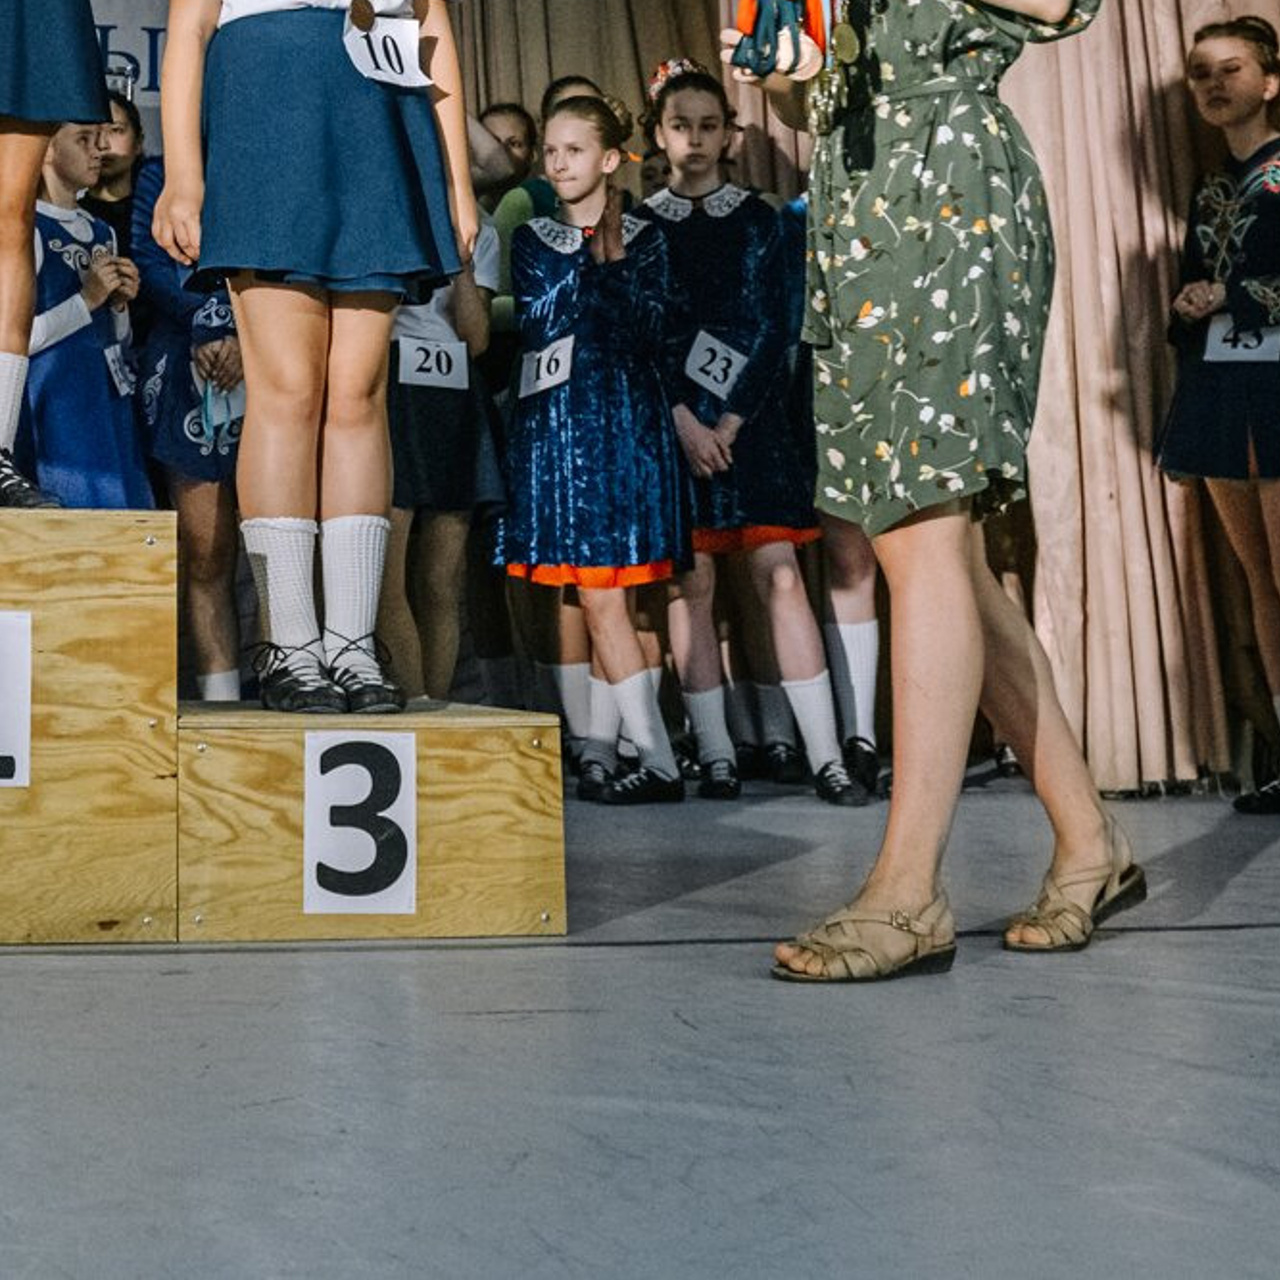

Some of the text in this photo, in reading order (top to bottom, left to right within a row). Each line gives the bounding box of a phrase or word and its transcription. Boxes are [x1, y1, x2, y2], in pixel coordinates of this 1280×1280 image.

[360, 32, 404, 75] 10
[415, 346, 452, 376] 20
[534, 347, 561, 382] 16
[698, 347, 732, 384] 23
[315, 740, 408, 897] 3
